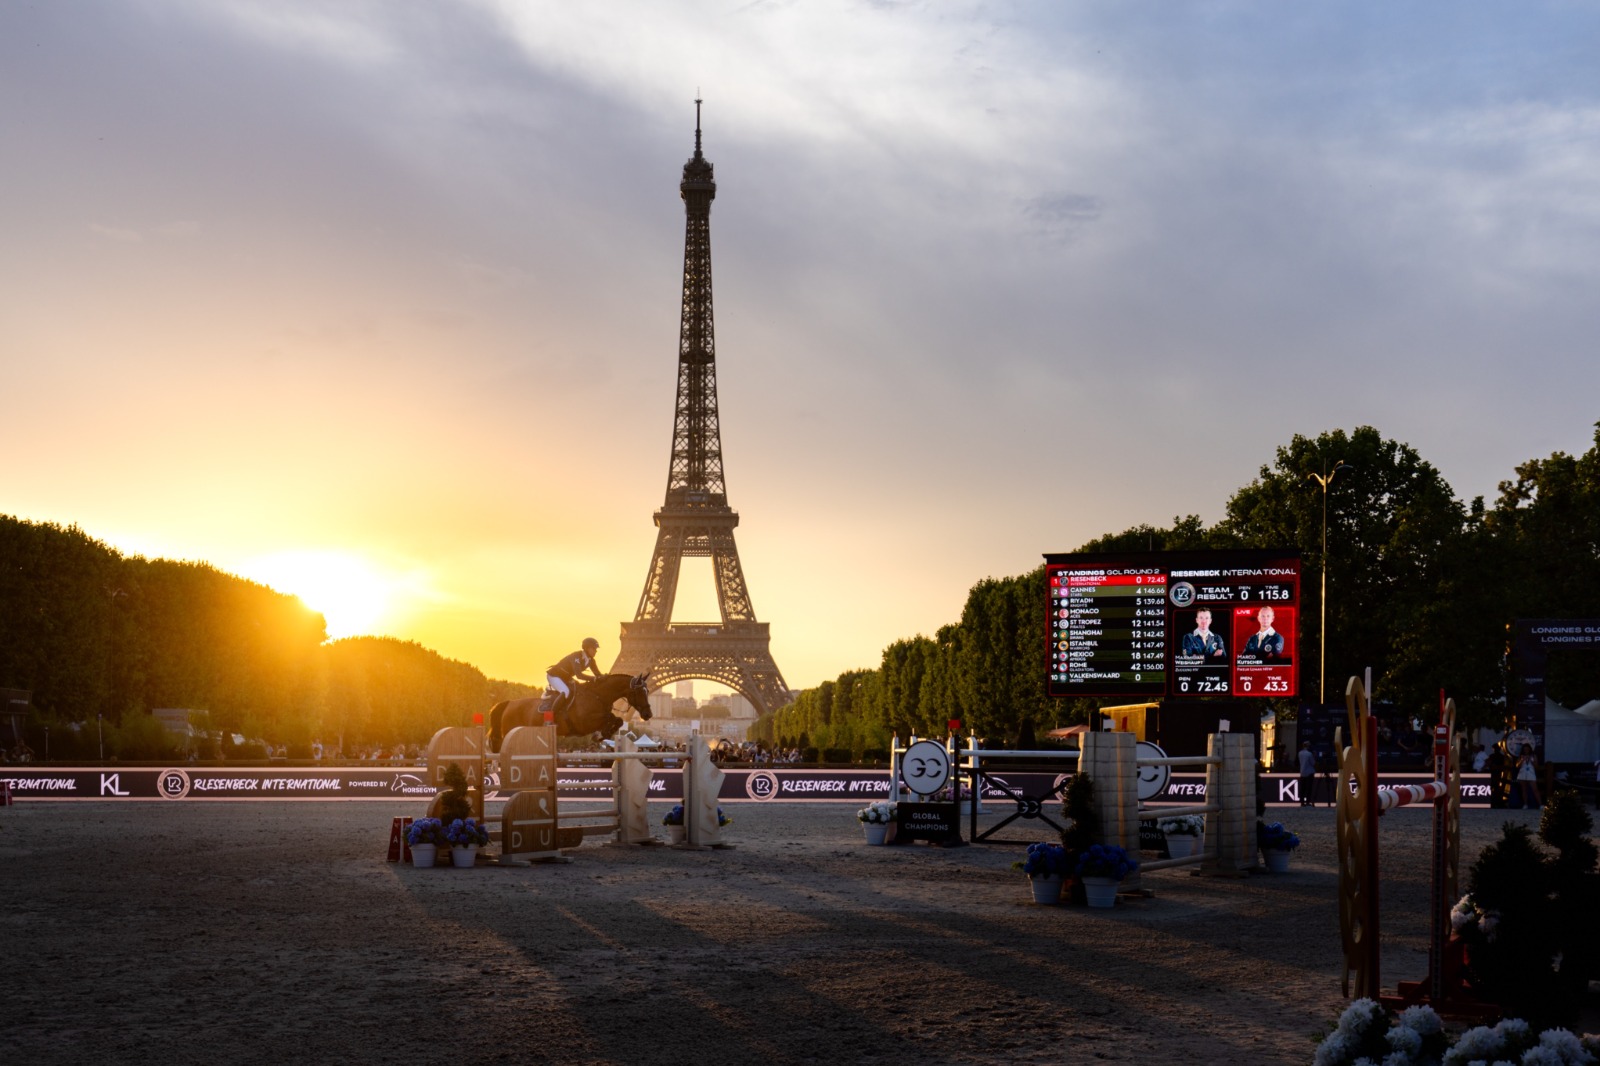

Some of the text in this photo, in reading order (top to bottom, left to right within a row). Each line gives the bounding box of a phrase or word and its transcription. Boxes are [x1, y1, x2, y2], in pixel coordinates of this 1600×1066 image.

[1240, 591, 1249, 600] 0
[1259, 590, 1289, 600] 115.8
[1131, 641, 1141, 649] 14
[1131, 652, 1141, 660] 18
[1180, 682, 1188, 691] 0
[1197, 682, 1228, 692] 72.45
[1243, 682, 1251, 691] 0
[1264, 682, 1288, 691] 43.3
[100, 773, 130, 796] KL
[261, 778, 342, 790] INTERNATIONAL
[912, 813, 941, 821] GLOBAL
[904, 822, 949, 832] CHAMPIONS
